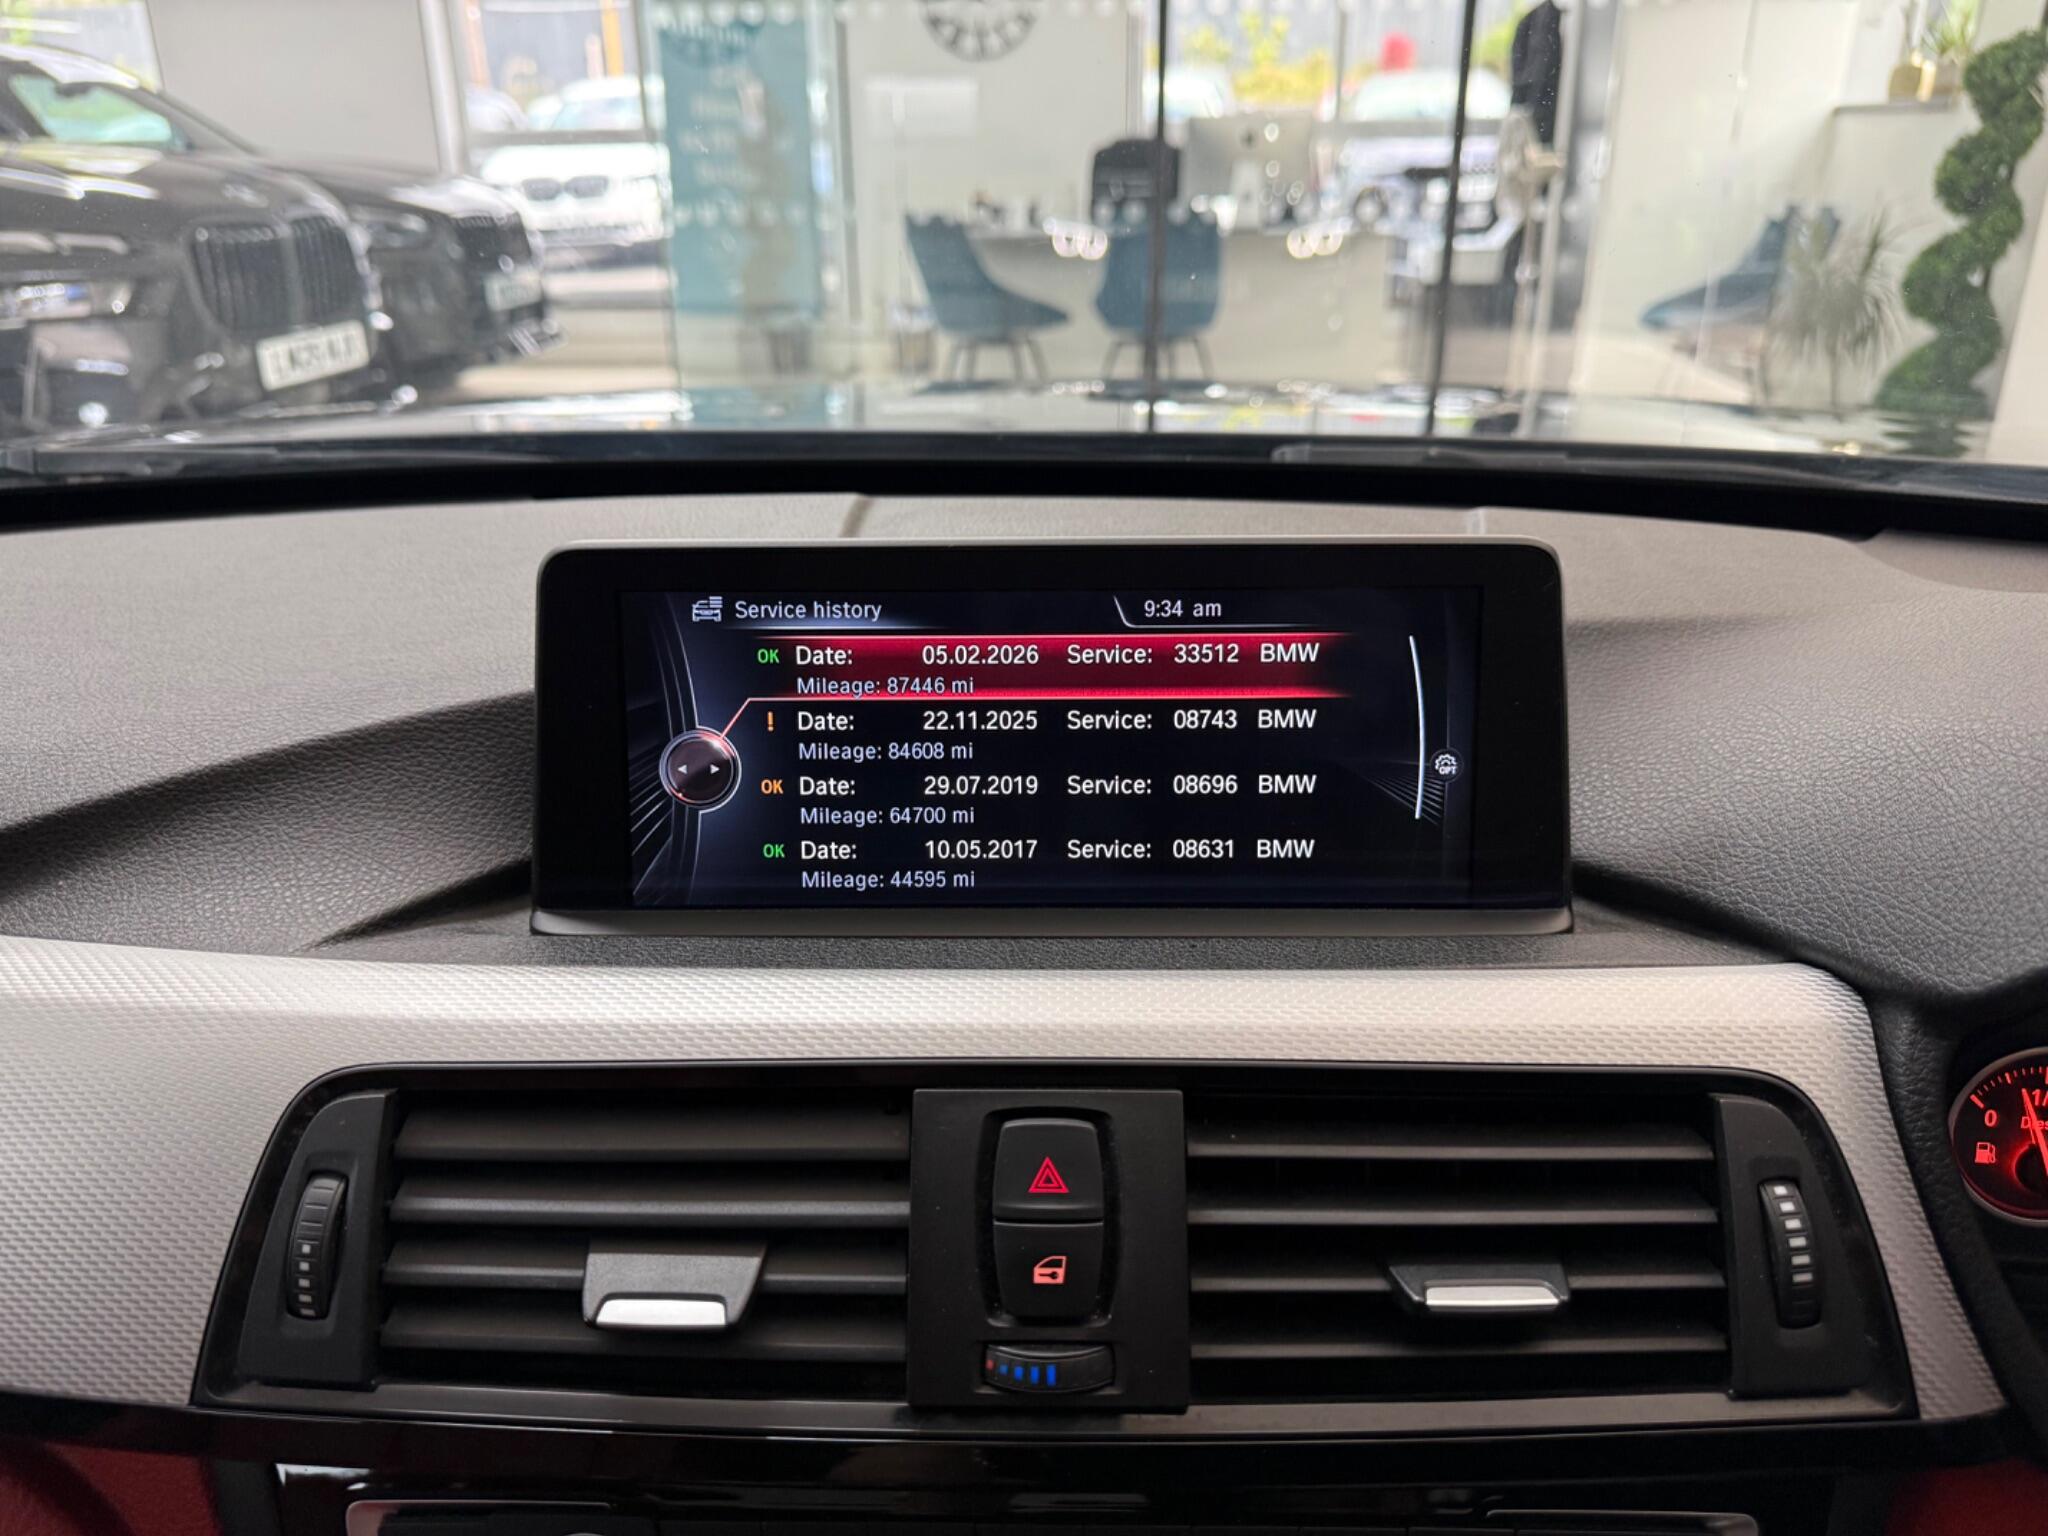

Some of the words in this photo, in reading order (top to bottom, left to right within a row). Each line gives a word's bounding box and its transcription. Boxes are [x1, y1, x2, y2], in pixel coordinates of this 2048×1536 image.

[735, 601, 806, 619] Service
[813, 600, 882, 621] history
[1143, 599, 1184, 618] 9:34
[1192, 602, 1222, 618] am
[757, 648, 780, 664] OK
[795, 645, 853, 665] Date:
[922, 644, 1039, 665] 05.02.2026
[1067, 644, 1153, 665] Service:
[1174, 643, 1239, 664] 33512
[1260, 642, 1320, 663] BMW
[796, 677, 880, 698] Mileage:
[887, 676, 946, 695] 87446
[951, 676, 974, 694] mi
[797, 710, 854, 731] Date:
[923, 710, 1038, 731] 22.11.2025
[1067, 709, 1152, 730] Service:
[1173, 709, 1238, 730] 08743
[1258, 708, 1317, 729] BMW
[798, 742, 882, 763] Mileage:
[888, 741, 945, 760] 84608
[951, 741, 973, 759] mi
[760, 779, 784, 795] OK
[799, 776, 856, 796] Date:
[924, 775, 1039, 795] 29.07.2019
[1067, 774, 1152, 795] Service:
[1173, 774, 1238, 795] 08696
[1258, 774, 1317, 794] BMW
[800, 807, 883, 828] Mileage:
[889, 806, 946, 824] 64700
[952, 806, 975, 824] mi
[762, 843, 785, 859] OK
[800, 840, 857, 860] Date:
[925, 839, 1038, 859] 10.05.2017
[1067, 839, 1151, 859] Service:
[1172, 839, 1234, 859] 08631
[1256, 839, 1315, 859] BMW
[802, 870, 884, 892] Mileage:
[890, 870, 946, 888] 44595
[953, 870, 975, 888] mi
[1984, 1109, 1998, 1128] 0
